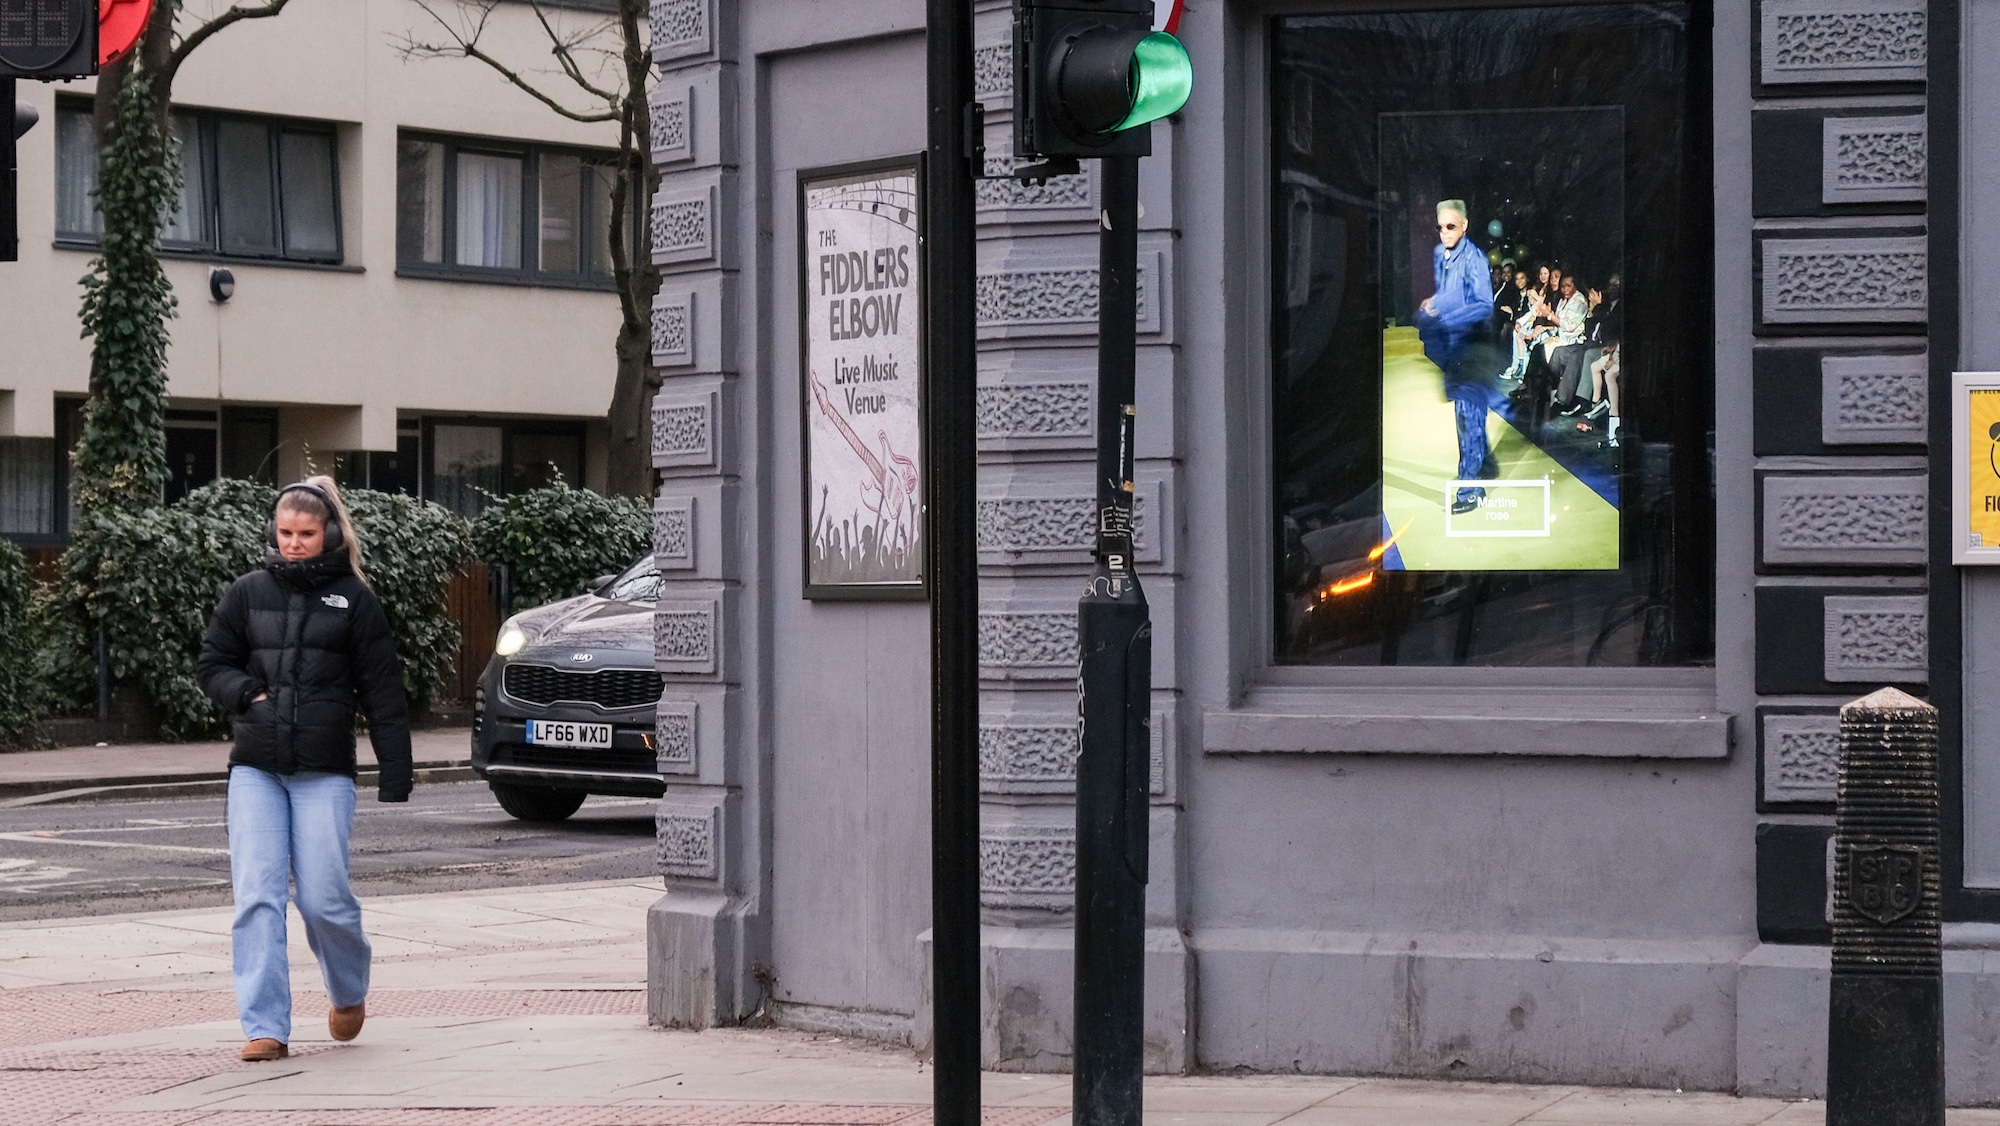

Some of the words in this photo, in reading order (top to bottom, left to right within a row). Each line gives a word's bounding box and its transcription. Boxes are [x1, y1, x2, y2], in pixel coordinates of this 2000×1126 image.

[819, 229, 837, 247] THE
[820, 245, 909, 296] FIDDLERS
[829, 293, 902, 341] ELBOW
[834, 357, 861, 385] Live
[863, 353, 899, 383] Music
[844, 387, 886, 415] Venue
[1477, 496, 1518, 508] Martine
[1485, 511, 1510, 521] rose
[1108, 554, 1124, 570] 2
[535, 723, 574, 741] LF66
[579, 725, 608, 744] WXD
